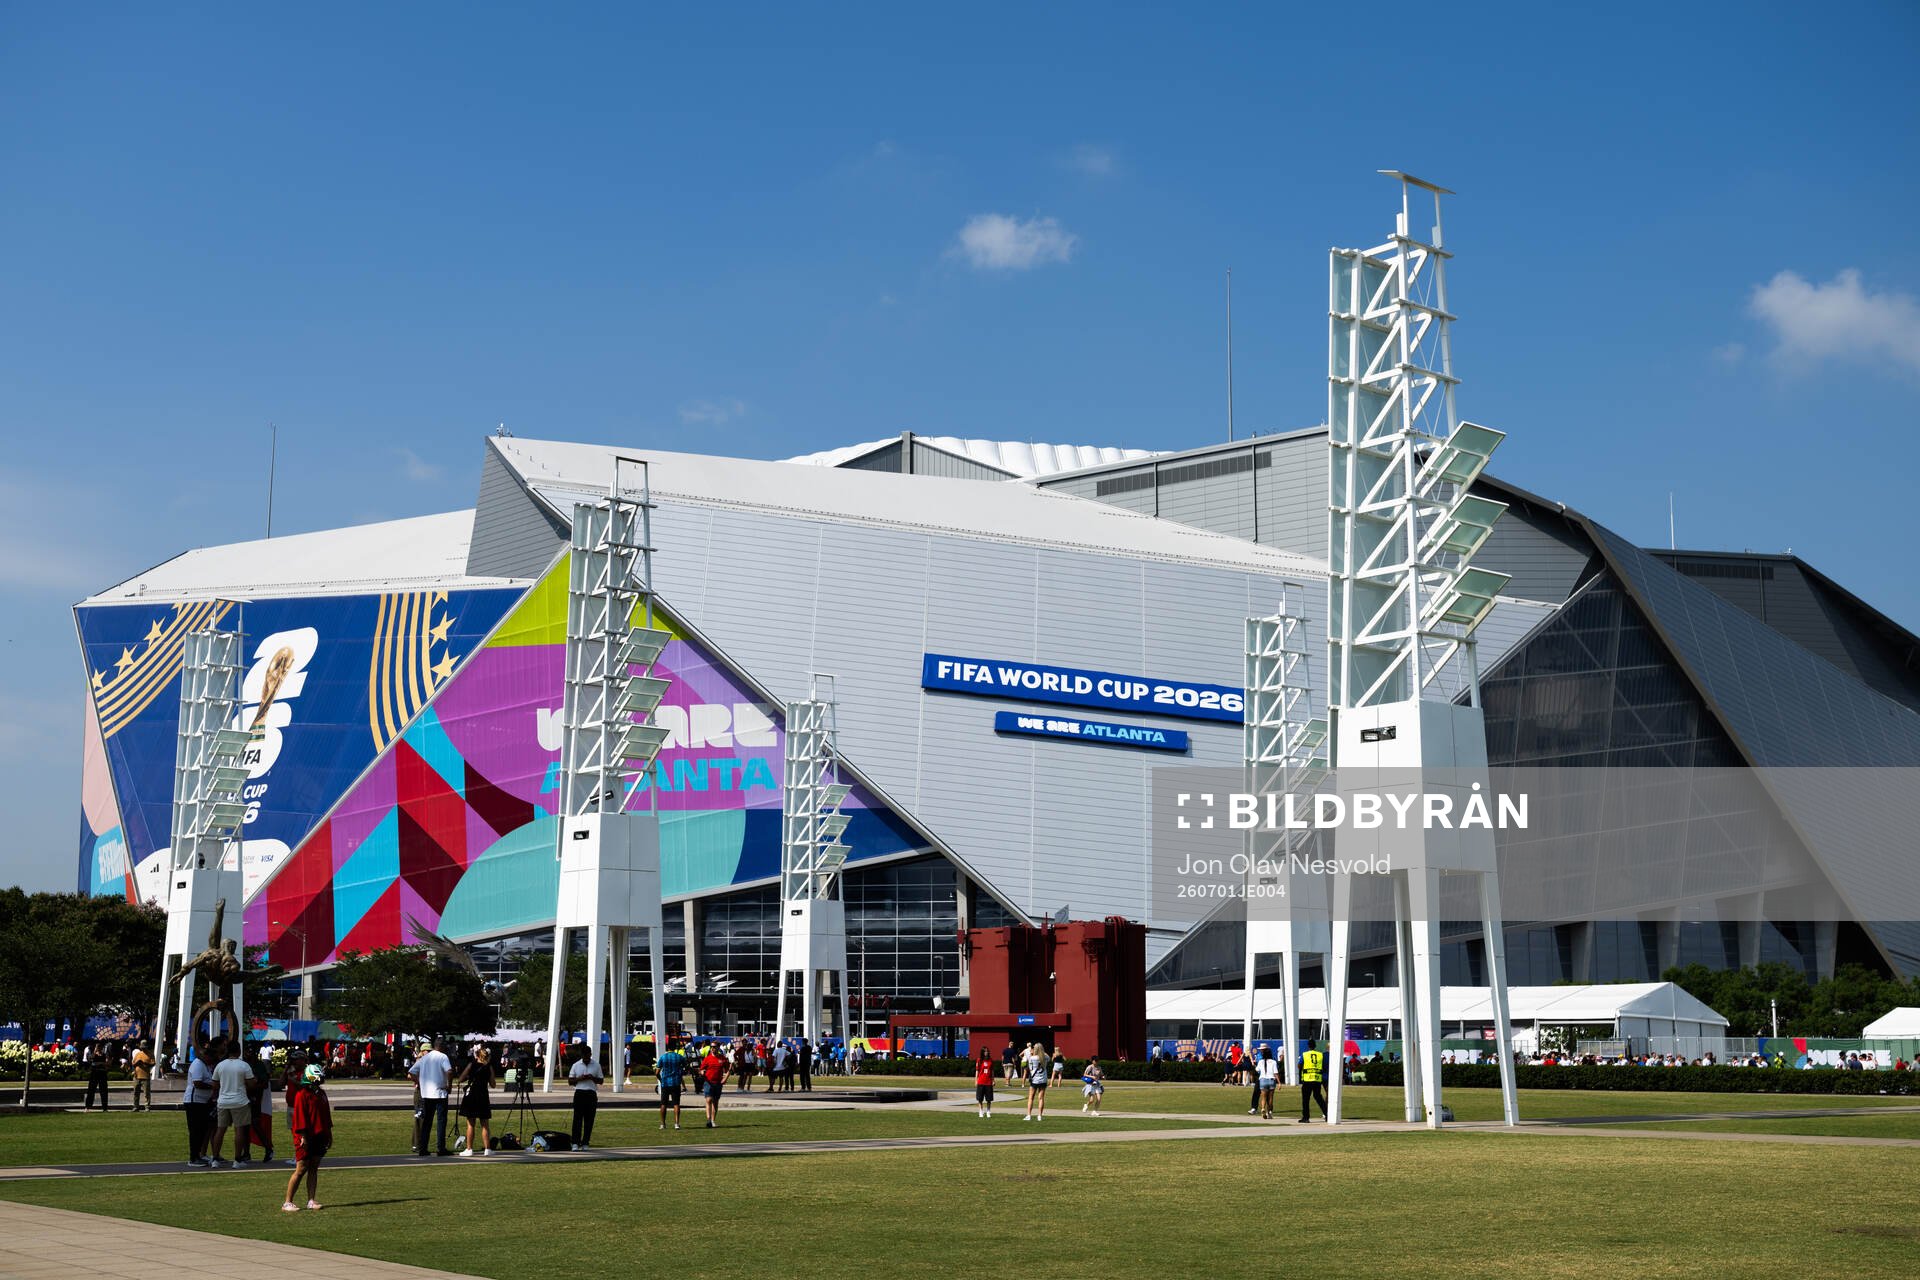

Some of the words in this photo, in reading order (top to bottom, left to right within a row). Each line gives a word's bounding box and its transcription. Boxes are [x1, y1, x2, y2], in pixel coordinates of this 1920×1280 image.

[937, 660, 994, 684] FIFA
[997, 667, 1093, 695] WORLD
[1097, 679, 1150, 701] CUP
[1153, 685, 1245, 712] 2026
[1017, 716, 1044, 730] WE
[1046, 719, 1081, 734] ARE
[1082, 724, 1166, 743] ATLANTA
[243, 783, 269, 799] CUP
[260, 854, 275, 863] VISA
